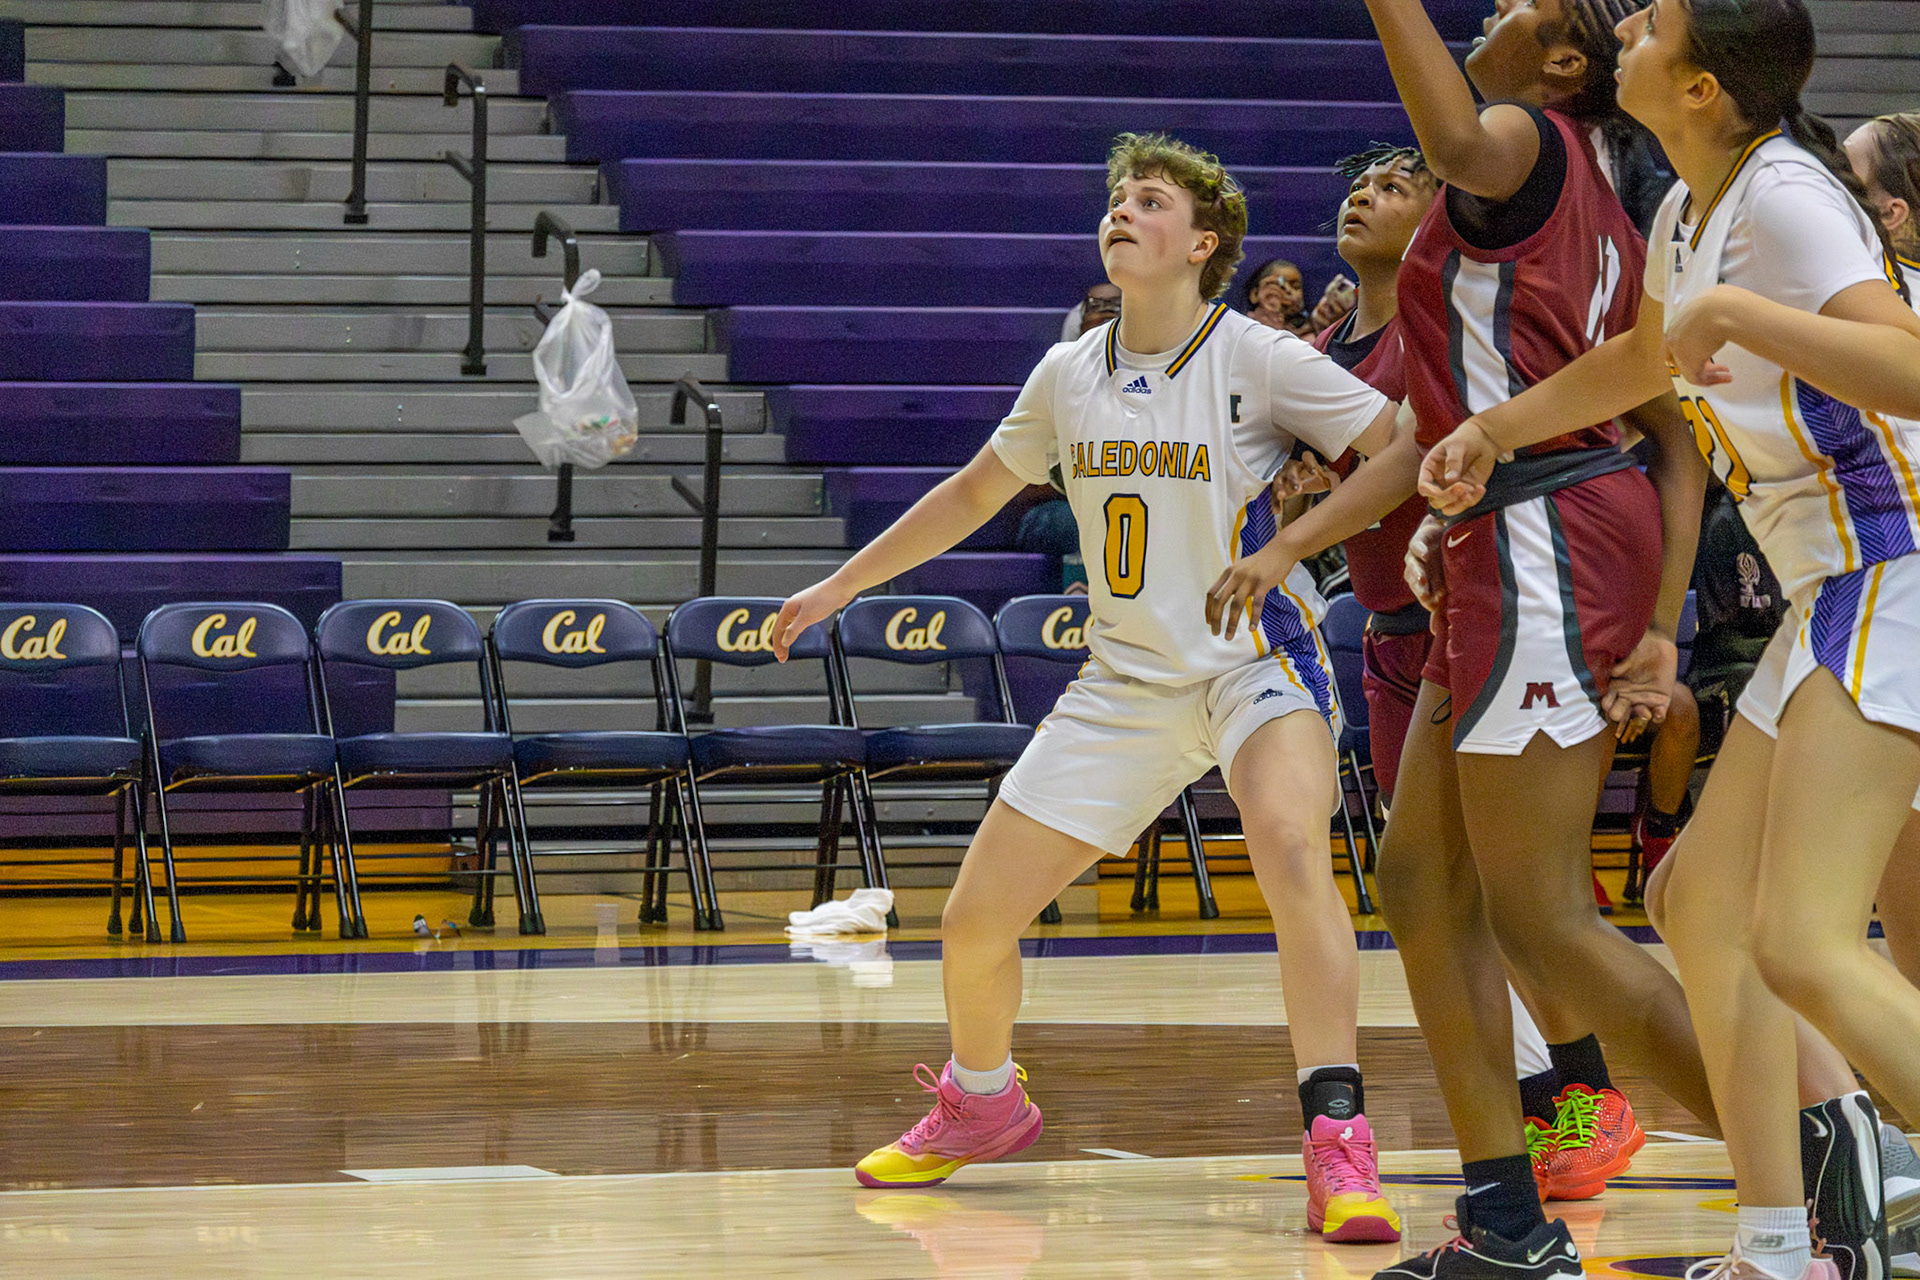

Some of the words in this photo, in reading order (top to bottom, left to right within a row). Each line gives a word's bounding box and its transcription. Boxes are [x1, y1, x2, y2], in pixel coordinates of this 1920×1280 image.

[1122, 385, 1152, 395] adidas
[1103, 492, 1148, 600] 0
[0, 614, 68, 660] Cal
[191, 612, 258, 659] Cal
[366, 610, 432, 656] Cal
[541, 609, 607, 655] Cal
[716, 607, 778, 653] Cal
[885, 606, 947, 651] Cal
[1519, 681, 1561, 710] M
